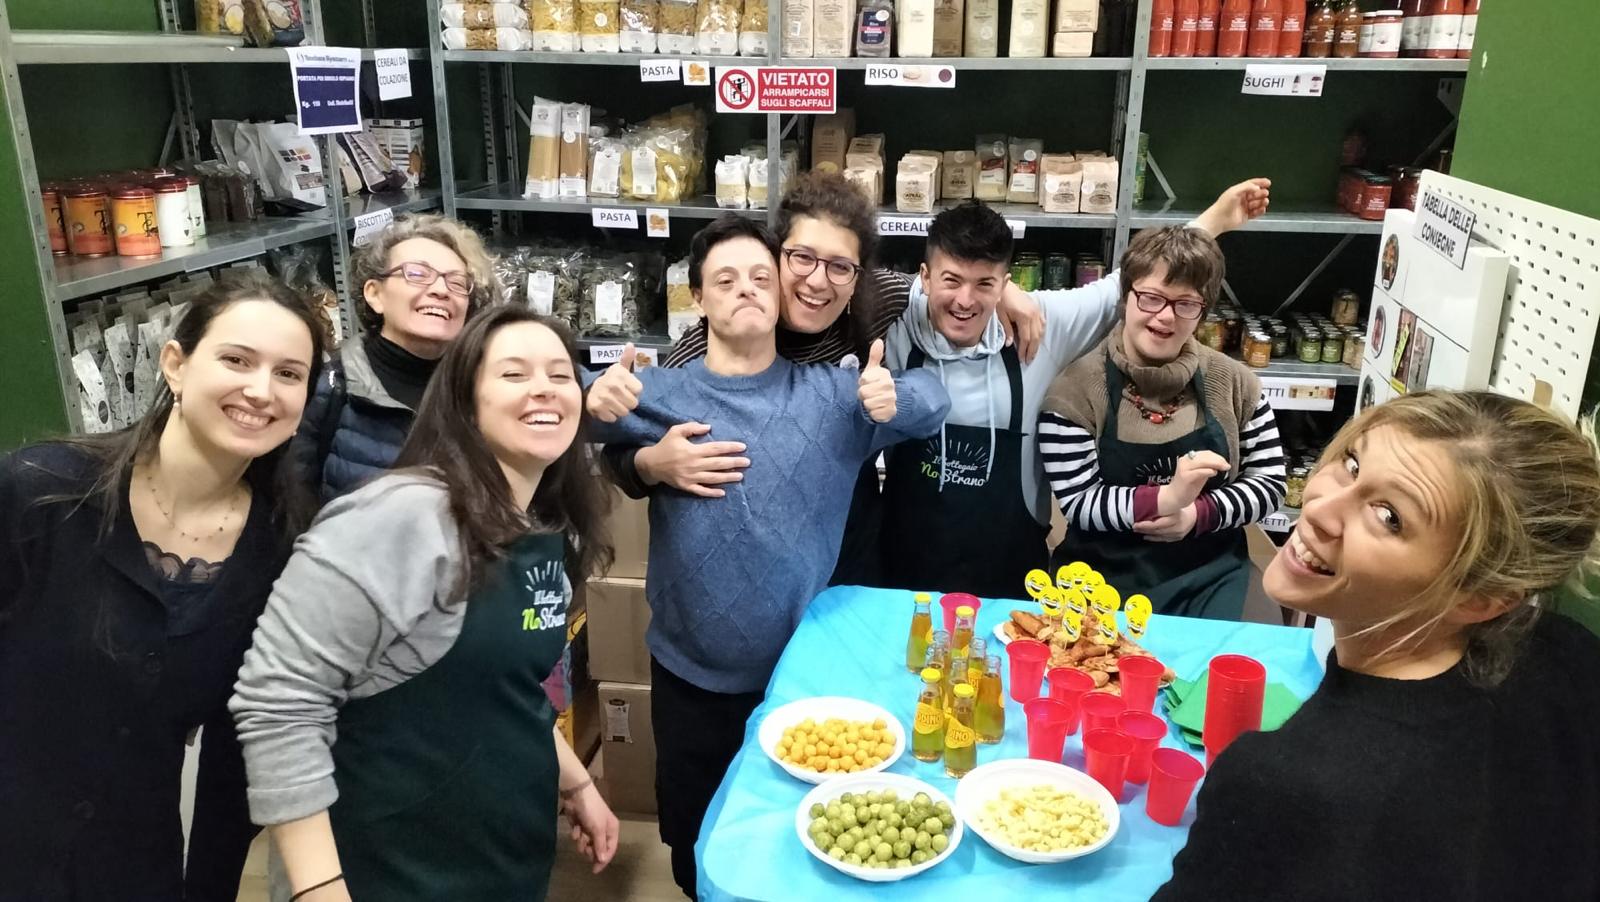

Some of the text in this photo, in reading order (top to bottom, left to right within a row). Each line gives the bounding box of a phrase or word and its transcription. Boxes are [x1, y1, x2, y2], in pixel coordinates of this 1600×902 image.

[377, 56, 407, 67] CEREALI DA
[641, 66, 674, 77] PASTA
[869, 68, 899, 79] RISO
[379, 73, 408, 85] COLAZIONE
[762, 72, 830, 86] VIETATO
[1243, 76, 1285, 88] SUGHI
[762, 88, 830, 97] ARRAMPICARSI
[760, 98, 832, 108] SUGLI SCAFFALI
[600, 212, 632, 222] PASTA
[1422, 192, 1471, 234] TABELLA DELLE
[357, 214, 384, 229] BISCOTTI
[1421, 222, 1456, 258] CONSEGNE
[942, 457, 978, 474] ottegaio
